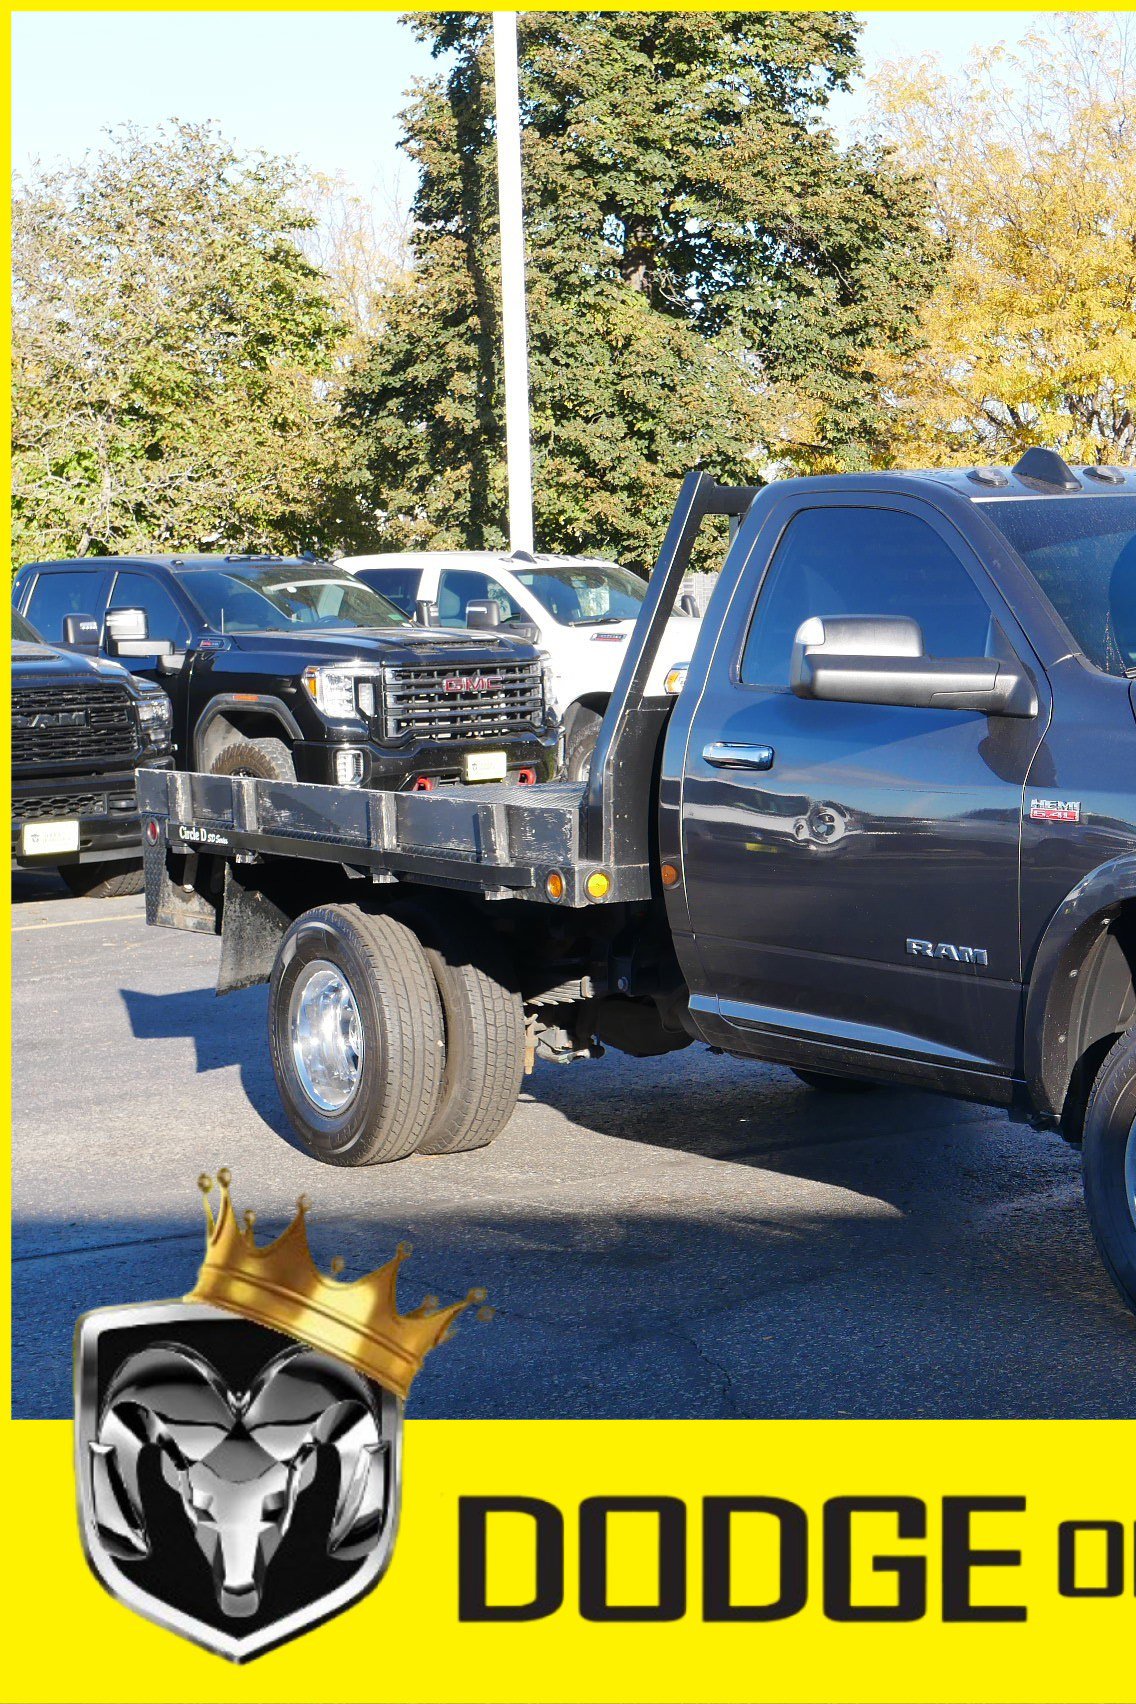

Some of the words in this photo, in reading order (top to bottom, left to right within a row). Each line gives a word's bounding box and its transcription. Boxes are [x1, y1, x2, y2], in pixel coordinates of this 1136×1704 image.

[443, 676, 504, 692] GMC
[1030, 799, 1081, 811] HEMI
[179, 825, 200, 840] Circle
[200, 828, 207, 841] D
[906, 938, 987, 965] RAM
